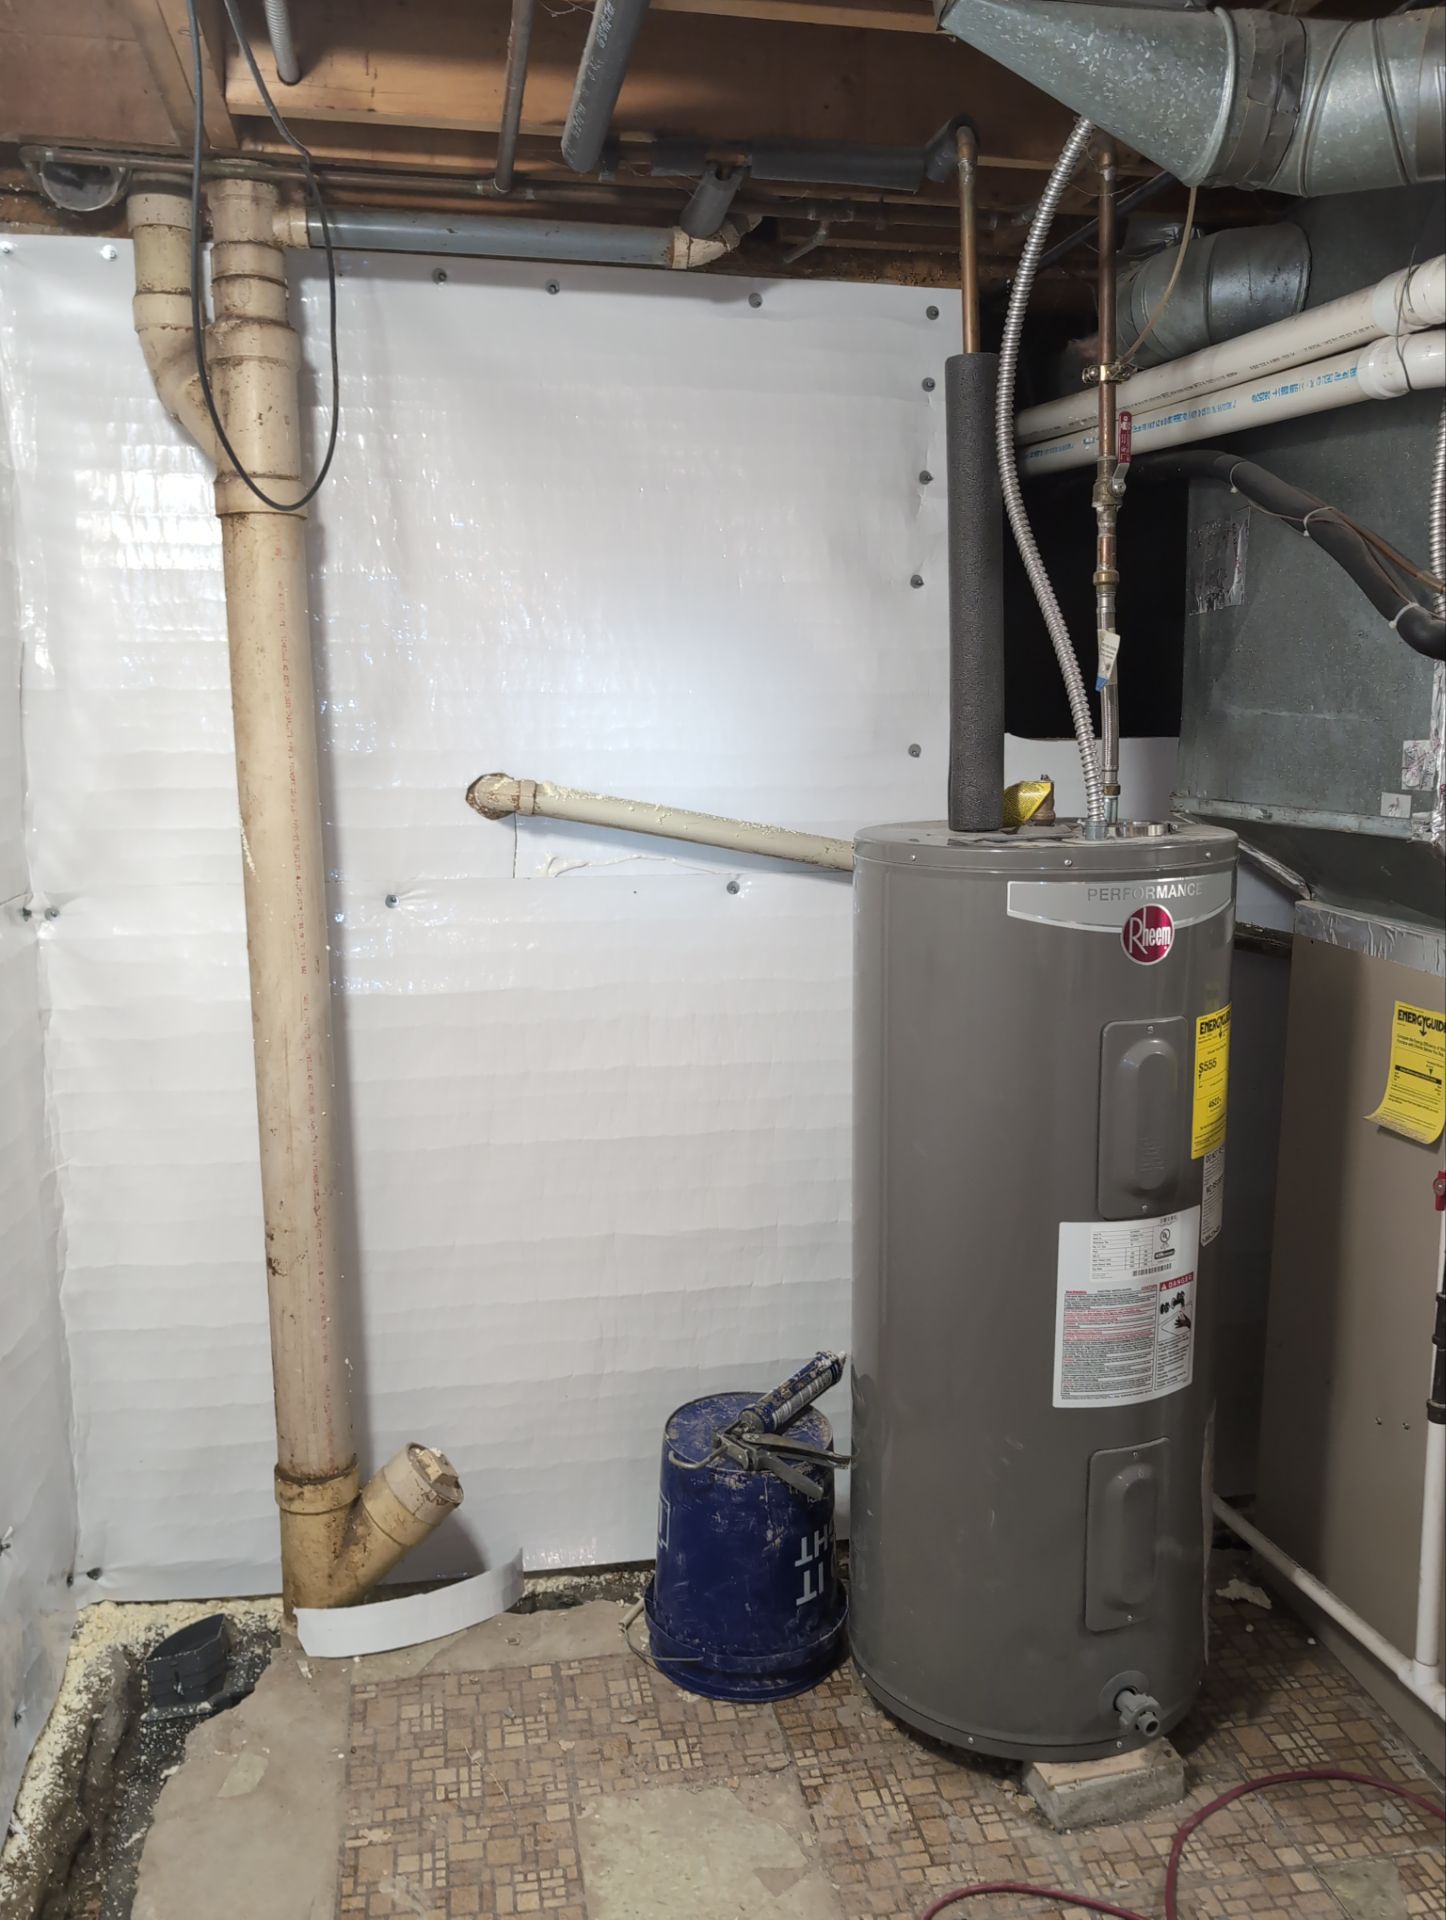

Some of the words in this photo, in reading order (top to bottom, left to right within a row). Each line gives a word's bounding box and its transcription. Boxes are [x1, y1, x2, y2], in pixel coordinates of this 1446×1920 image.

[1087, 882, 1203, 902] PERFORMANCE
[1128, 907, 1171, 954] Rheem
[795, 1561, 824, 1606] IT
